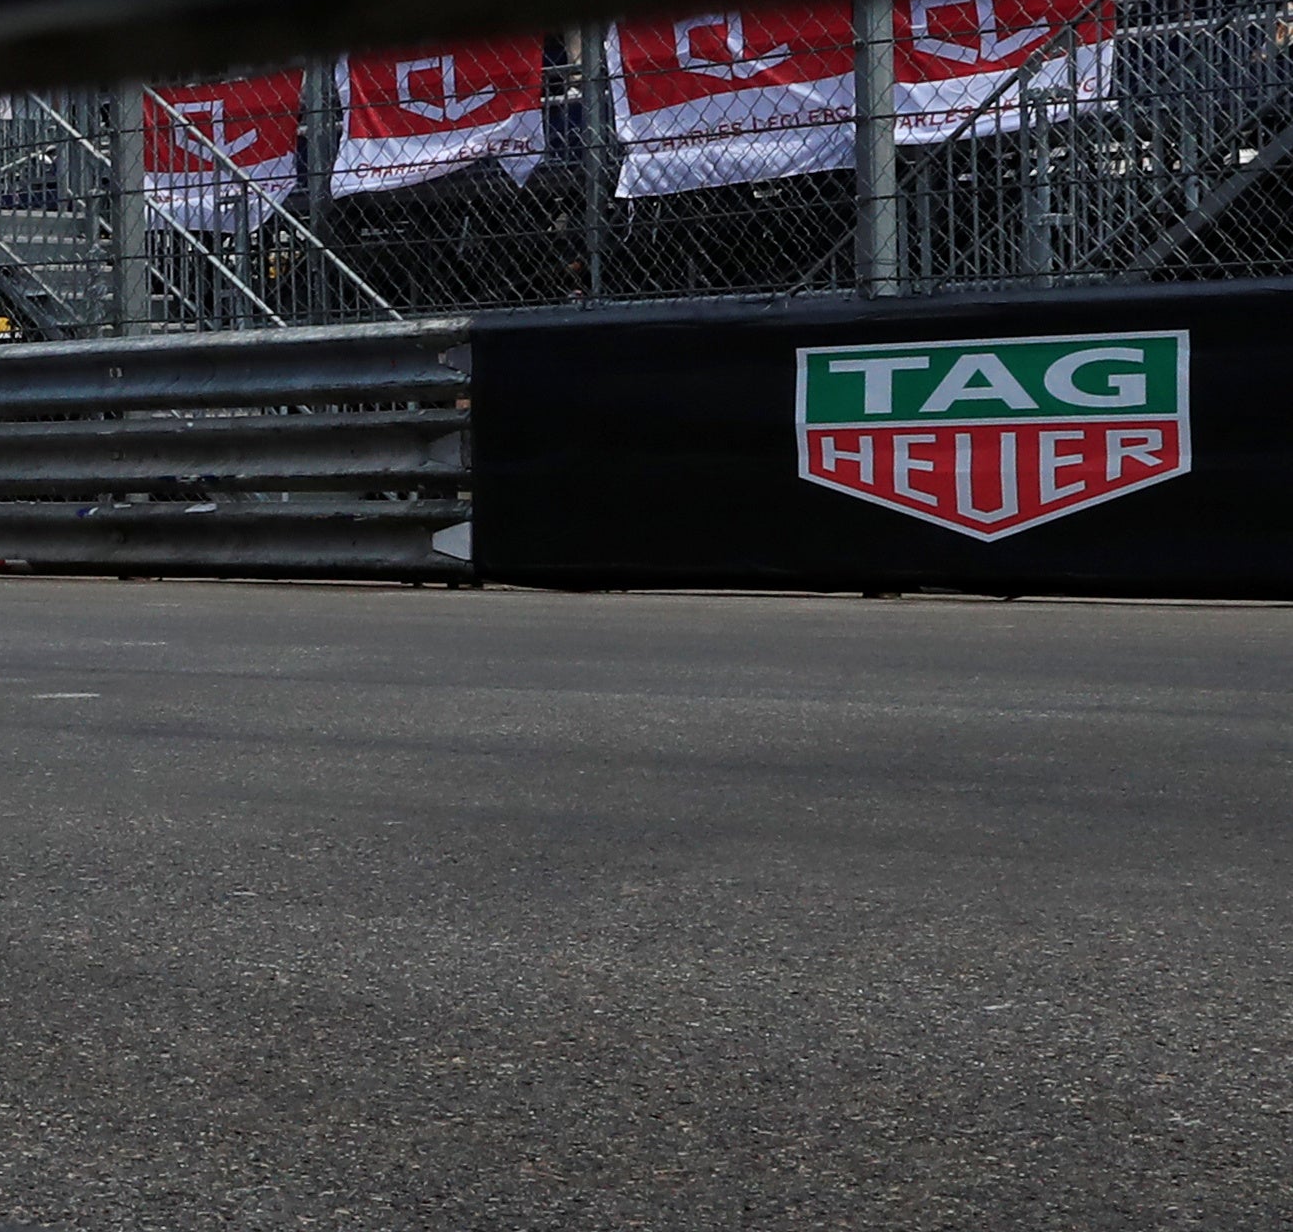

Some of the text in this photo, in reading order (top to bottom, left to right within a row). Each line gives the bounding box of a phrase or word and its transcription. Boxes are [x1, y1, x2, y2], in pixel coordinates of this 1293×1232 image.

[644, 106, 850, 153] CHARLES LECLERC
[892, 105, 972, 129] ARLES
[829, 347, 1146, 414] TAG
[821, 429, 1164, 524] HEUER
